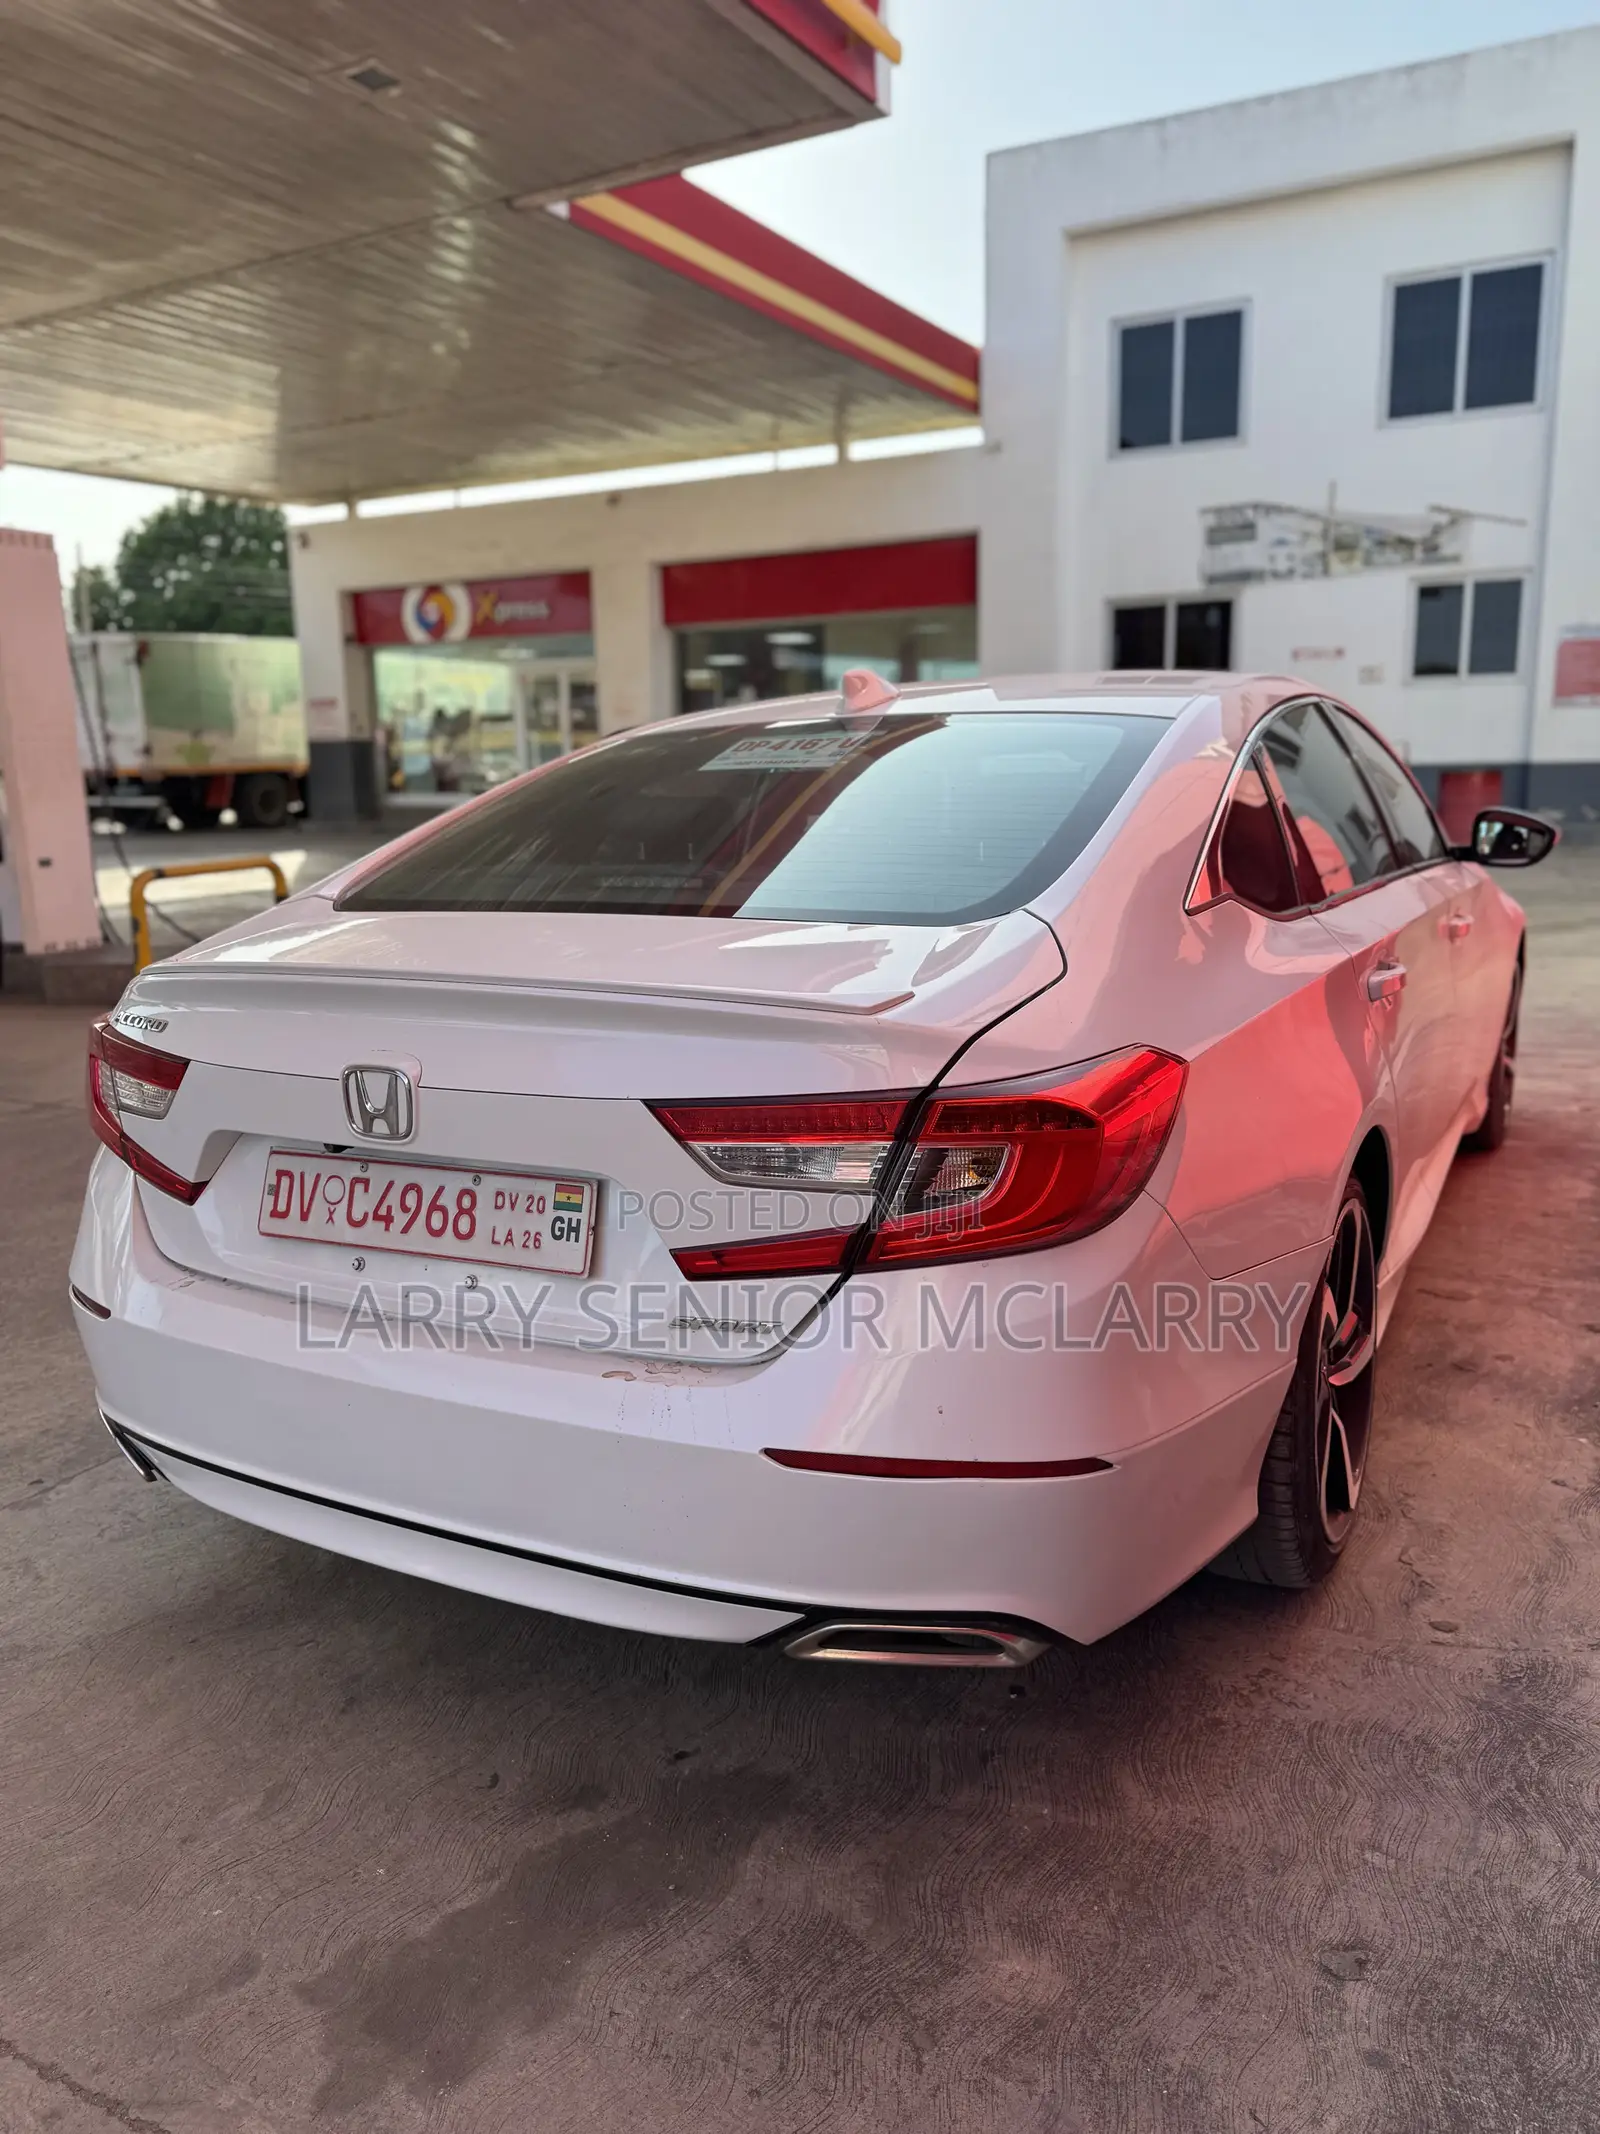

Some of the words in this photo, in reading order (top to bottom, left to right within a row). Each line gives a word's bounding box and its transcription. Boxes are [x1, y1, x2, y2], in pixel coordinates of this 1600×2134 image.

[115, 1010, 169, 1033] ACCORD
[269, 1168, 321, 1222] DV
[346, 1176, 478, 1241] C4968
[494, 1190, 521, 1212] DV
[525, 1194, 546, 1215] 20
[491, 1225, 515, 1248] LA
[521, 1229, 544, 1250] 26
[550, 1215, 582, 1243] GH
[668, 1316, 784, 1335] SPORT
